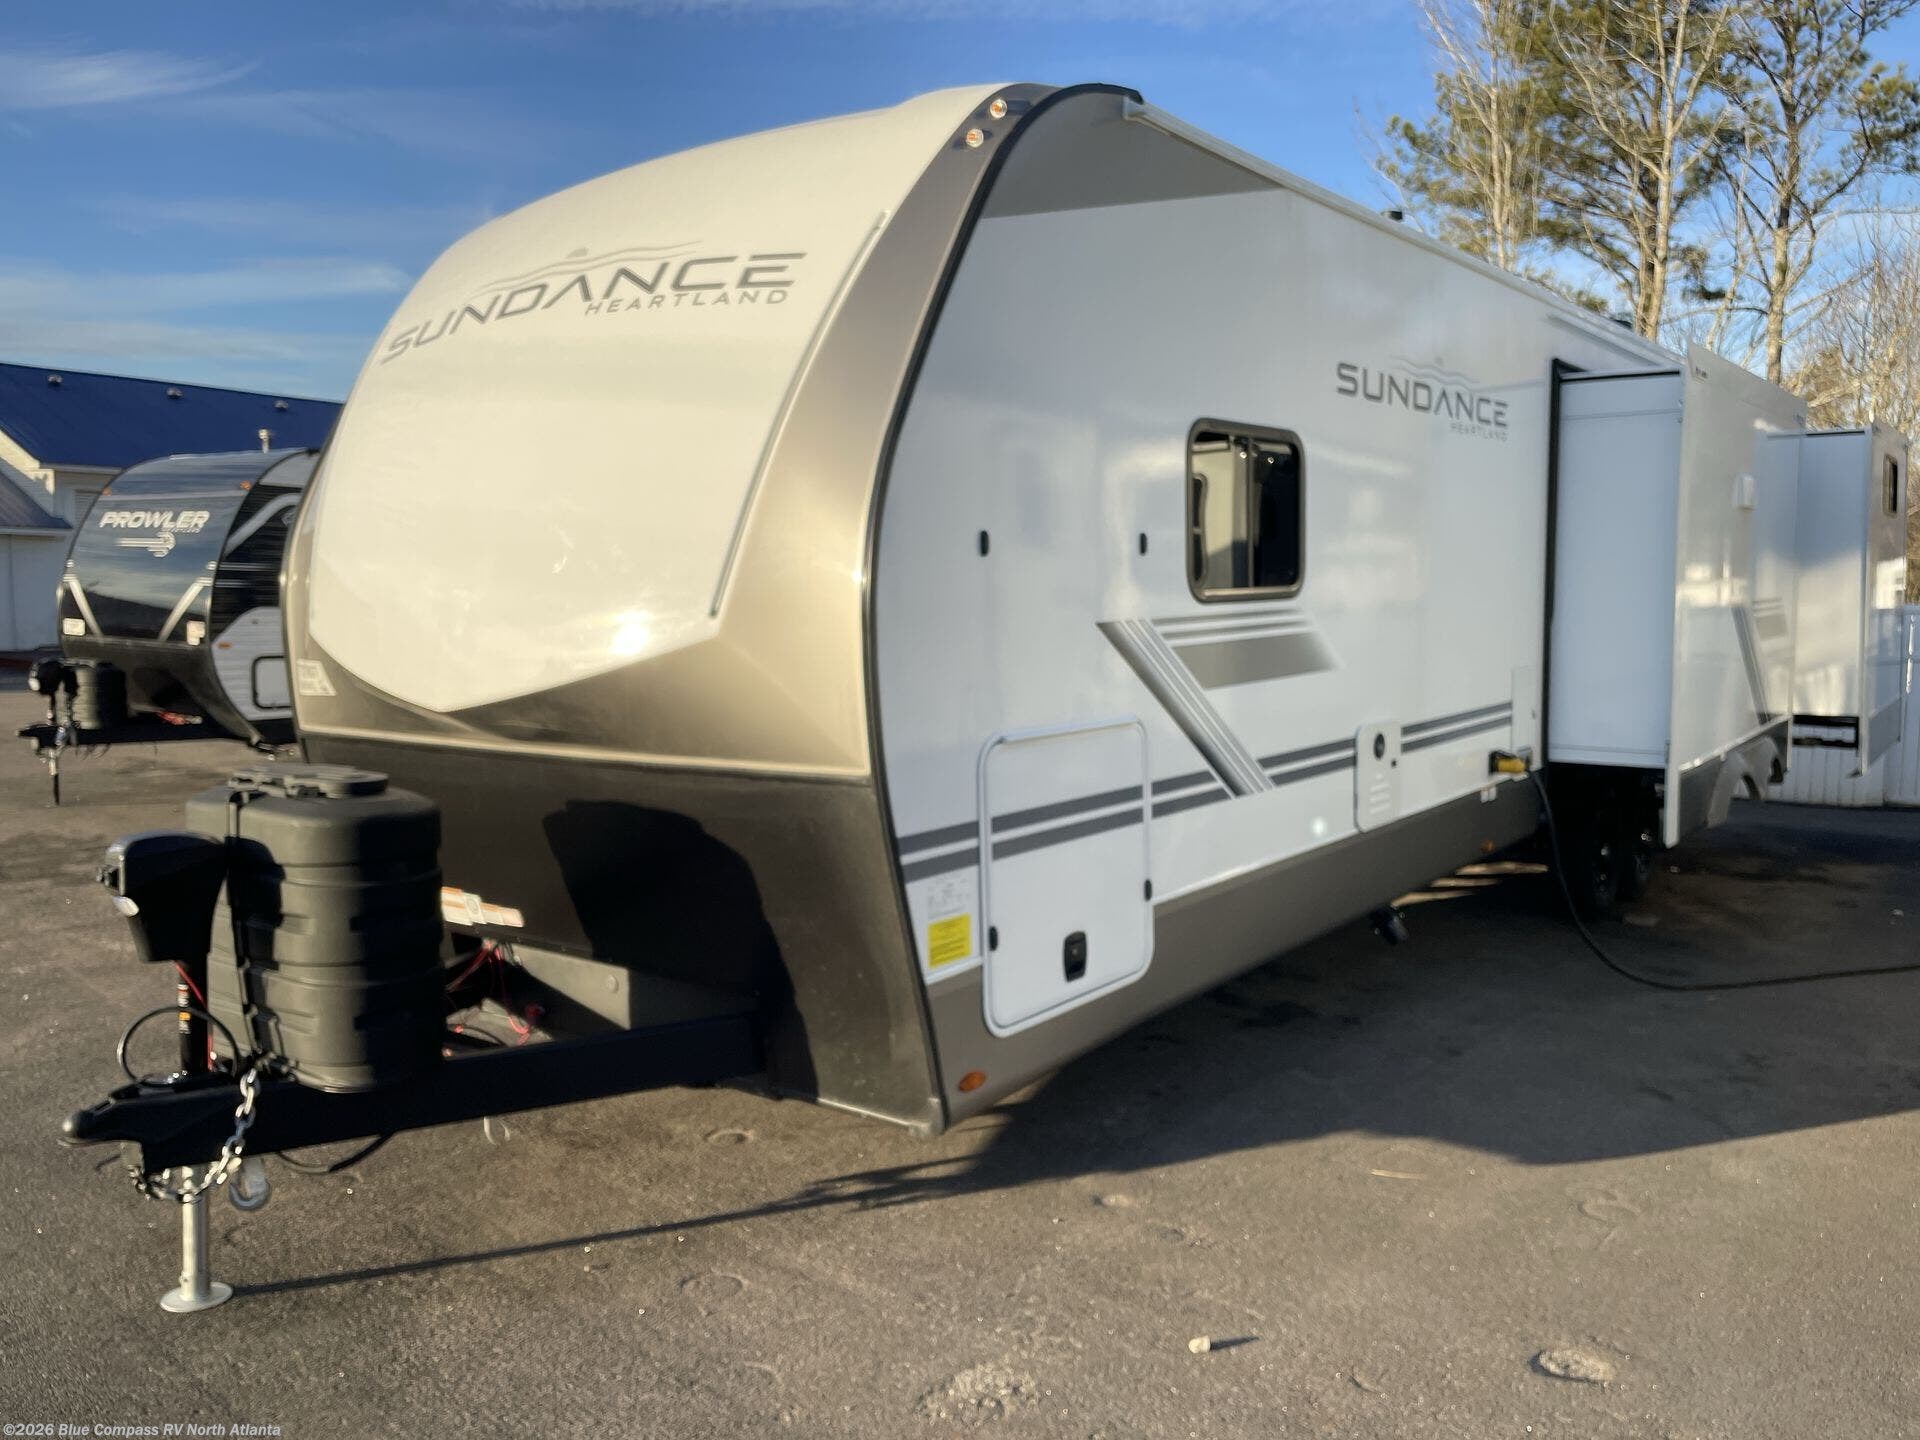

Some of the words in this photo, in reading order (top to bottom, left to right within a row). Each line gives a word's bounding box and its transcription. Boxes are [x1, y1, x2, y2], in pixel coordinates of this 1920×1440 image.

[380, 252, 808, 365] SUNDANCE
[584, 289, 789, 317] HEARTLAND
[1336, 361, 1509, 428] SUNDANCE
[98, 510, 210, 529] PROWLER
